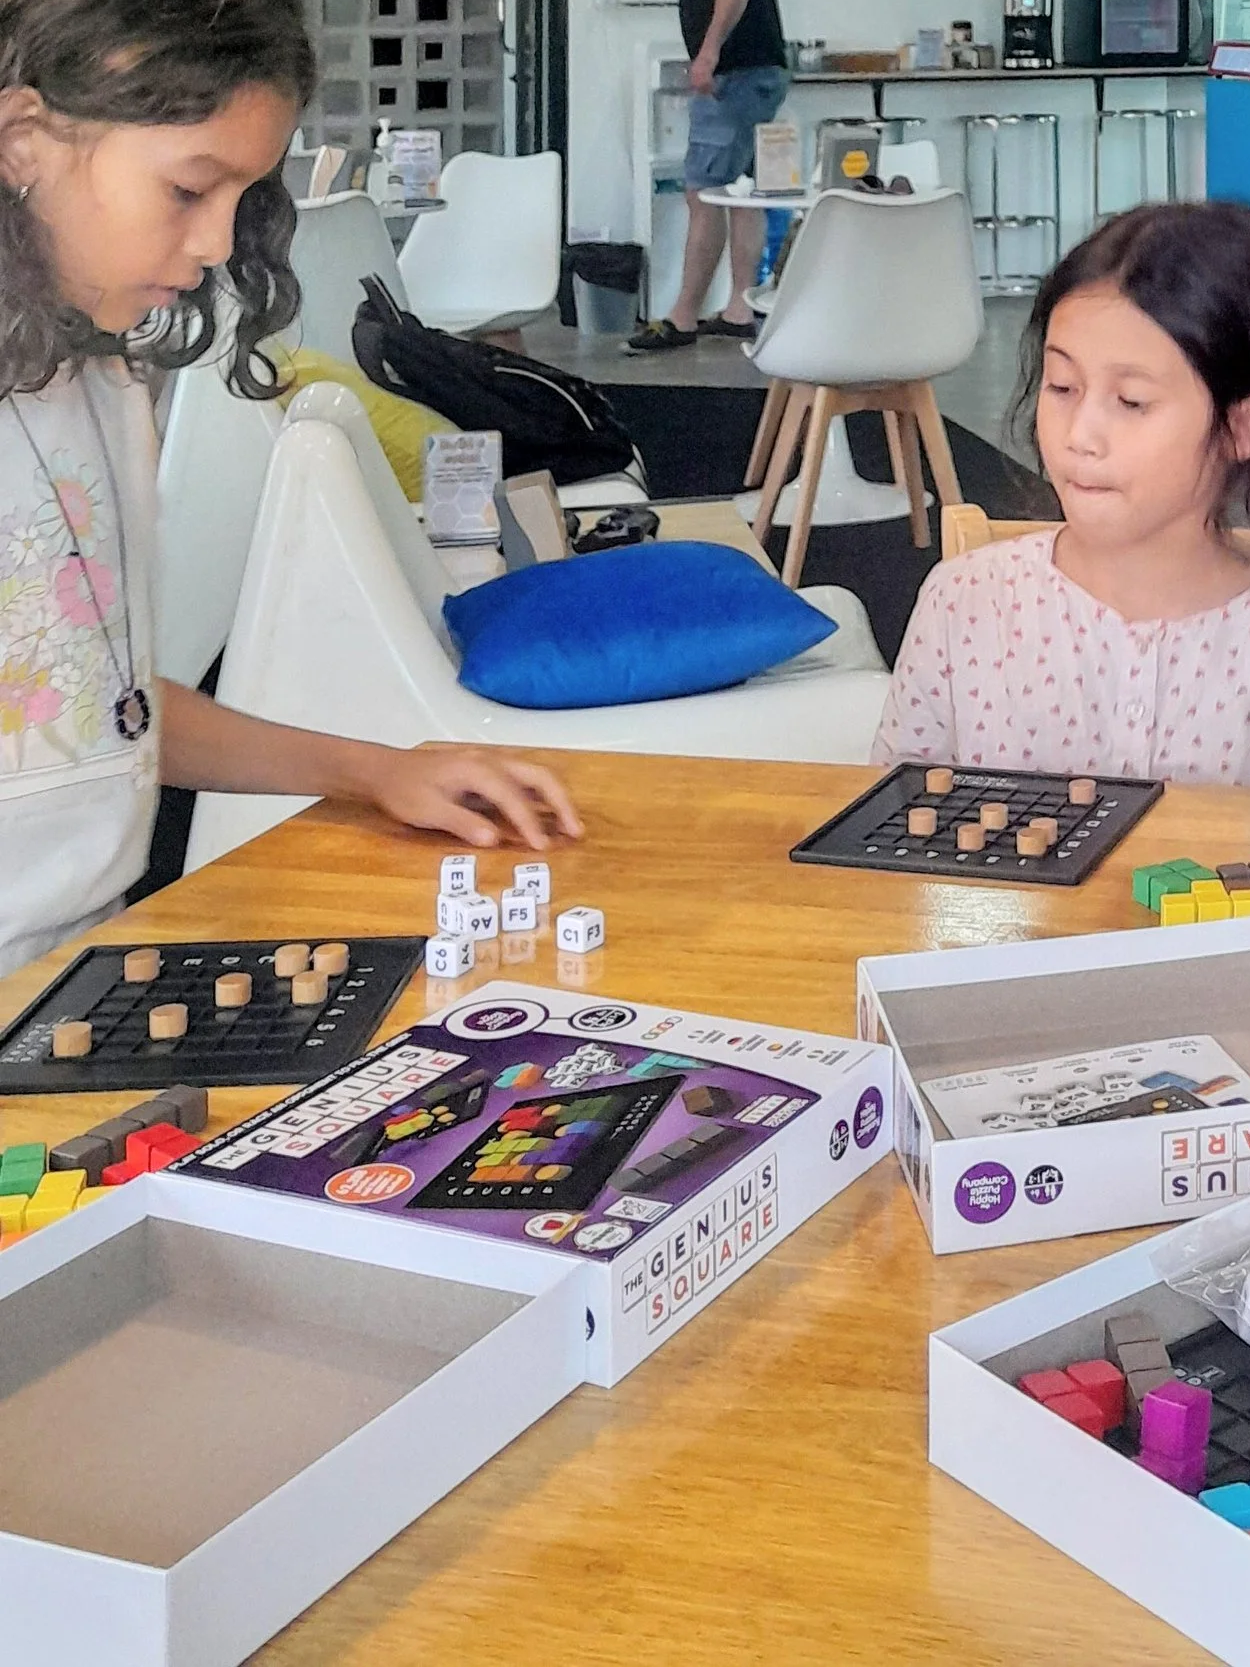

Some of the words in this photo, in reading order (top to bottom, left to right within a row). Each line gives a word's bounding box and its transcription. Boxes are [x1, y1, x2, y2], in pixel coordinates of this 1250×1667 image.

[450, 870, 464, 891] E3
[508, 907, 528, 922] F5
[562, 928, 580, 944] C1
[586, 923, 601, 941] F3
[435, 948, 447, 972] C6
[213, 1148, 249, 1167] THE
[250, 1049, 422, 1145] GENIUS
[284, 1055, 458, 1152] SQUARE
[961, 1175, 1009, 1189] Company
[969, 1185, 1000, 1196] Puzzle
[969, 1195, 1001, 1206] Happy
[624, 1271, 643, 1296] THE
[651, 1164, 772, 1277] GENIUS
[652, 1202, 773, 1320] SQUARE
